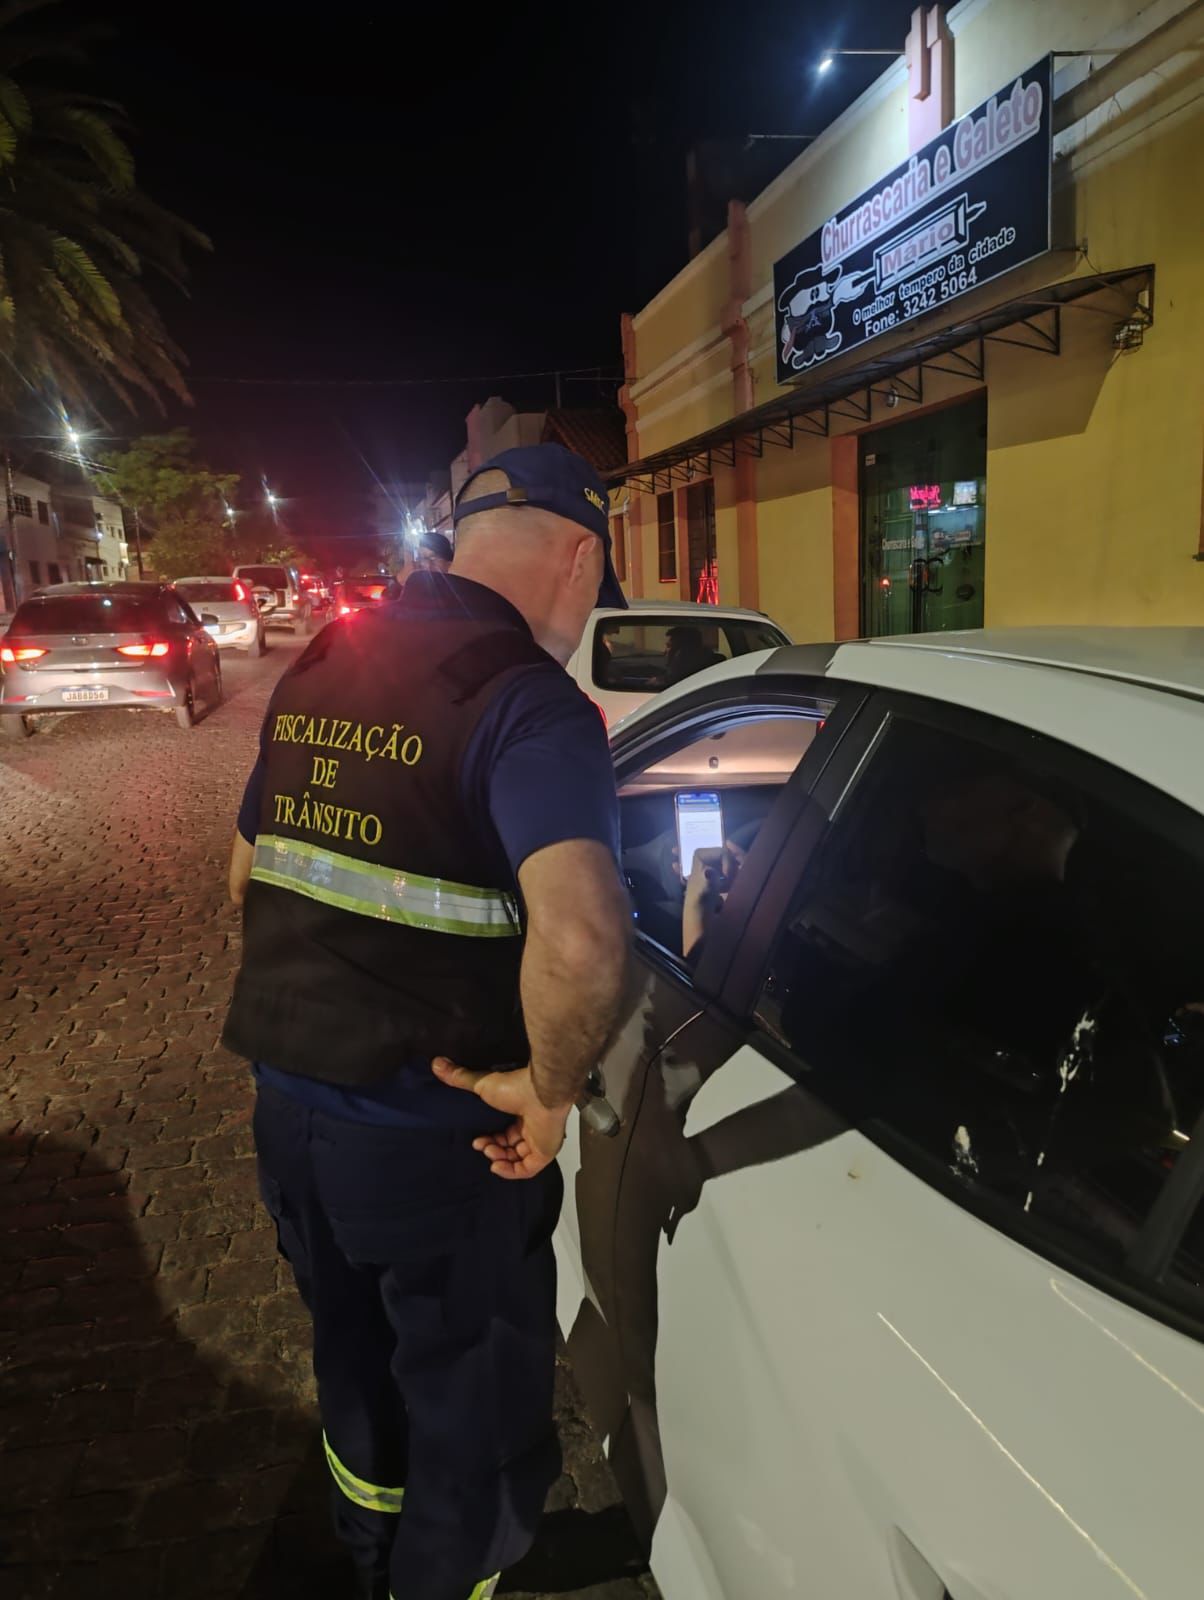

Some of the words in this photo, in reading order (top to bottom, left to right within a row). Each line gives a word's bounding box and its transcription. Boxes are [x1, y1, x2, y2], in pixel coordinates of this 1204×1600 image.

[821, 156, 931, 264] Churrascaria
[934, 145, 950, 185] e
[954, 79, 1042, 172] Galeto
[861, 291, 895, 321] melhor
[899, 265, 946, 301] tempero
[948, 254, 965, 275] da
[968, 226, 1016, 265] cidade
[865, 310, 899, 337] Fone:
[904, 288, 936, 318] 3242
[941, 266, 978, 299] 5064
[273, 714, 423, 766] FISCALIZAÇÃO
[310, 756, 339, 789] DE
[274, 791, 383, 845] TRÂNSITO
